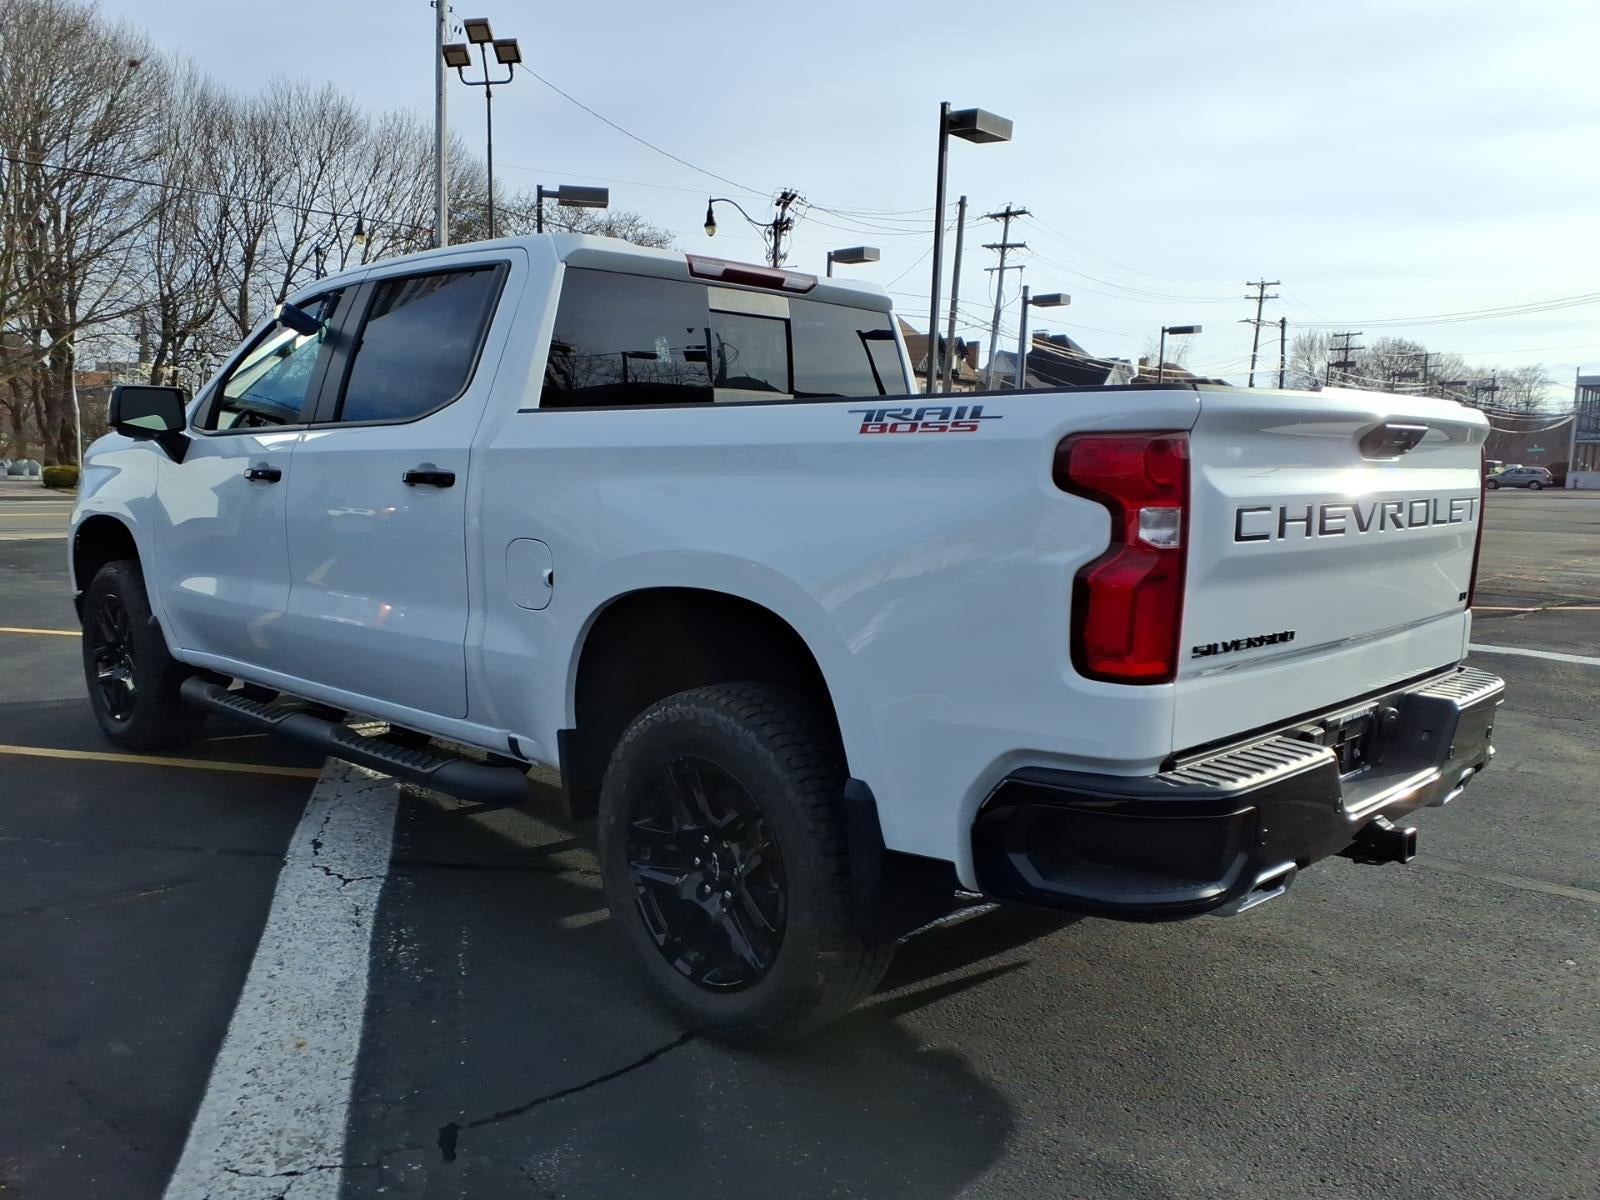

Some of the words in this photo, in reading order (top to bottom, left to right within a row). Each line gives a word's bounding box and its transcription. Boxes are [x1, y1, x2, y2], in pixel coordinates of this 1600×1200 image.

[848, 405, 1003, 422] TRAIL
[859, 420, 980, 434] BOSS
[1234, 497, 1477, 543] CHEVROLET
